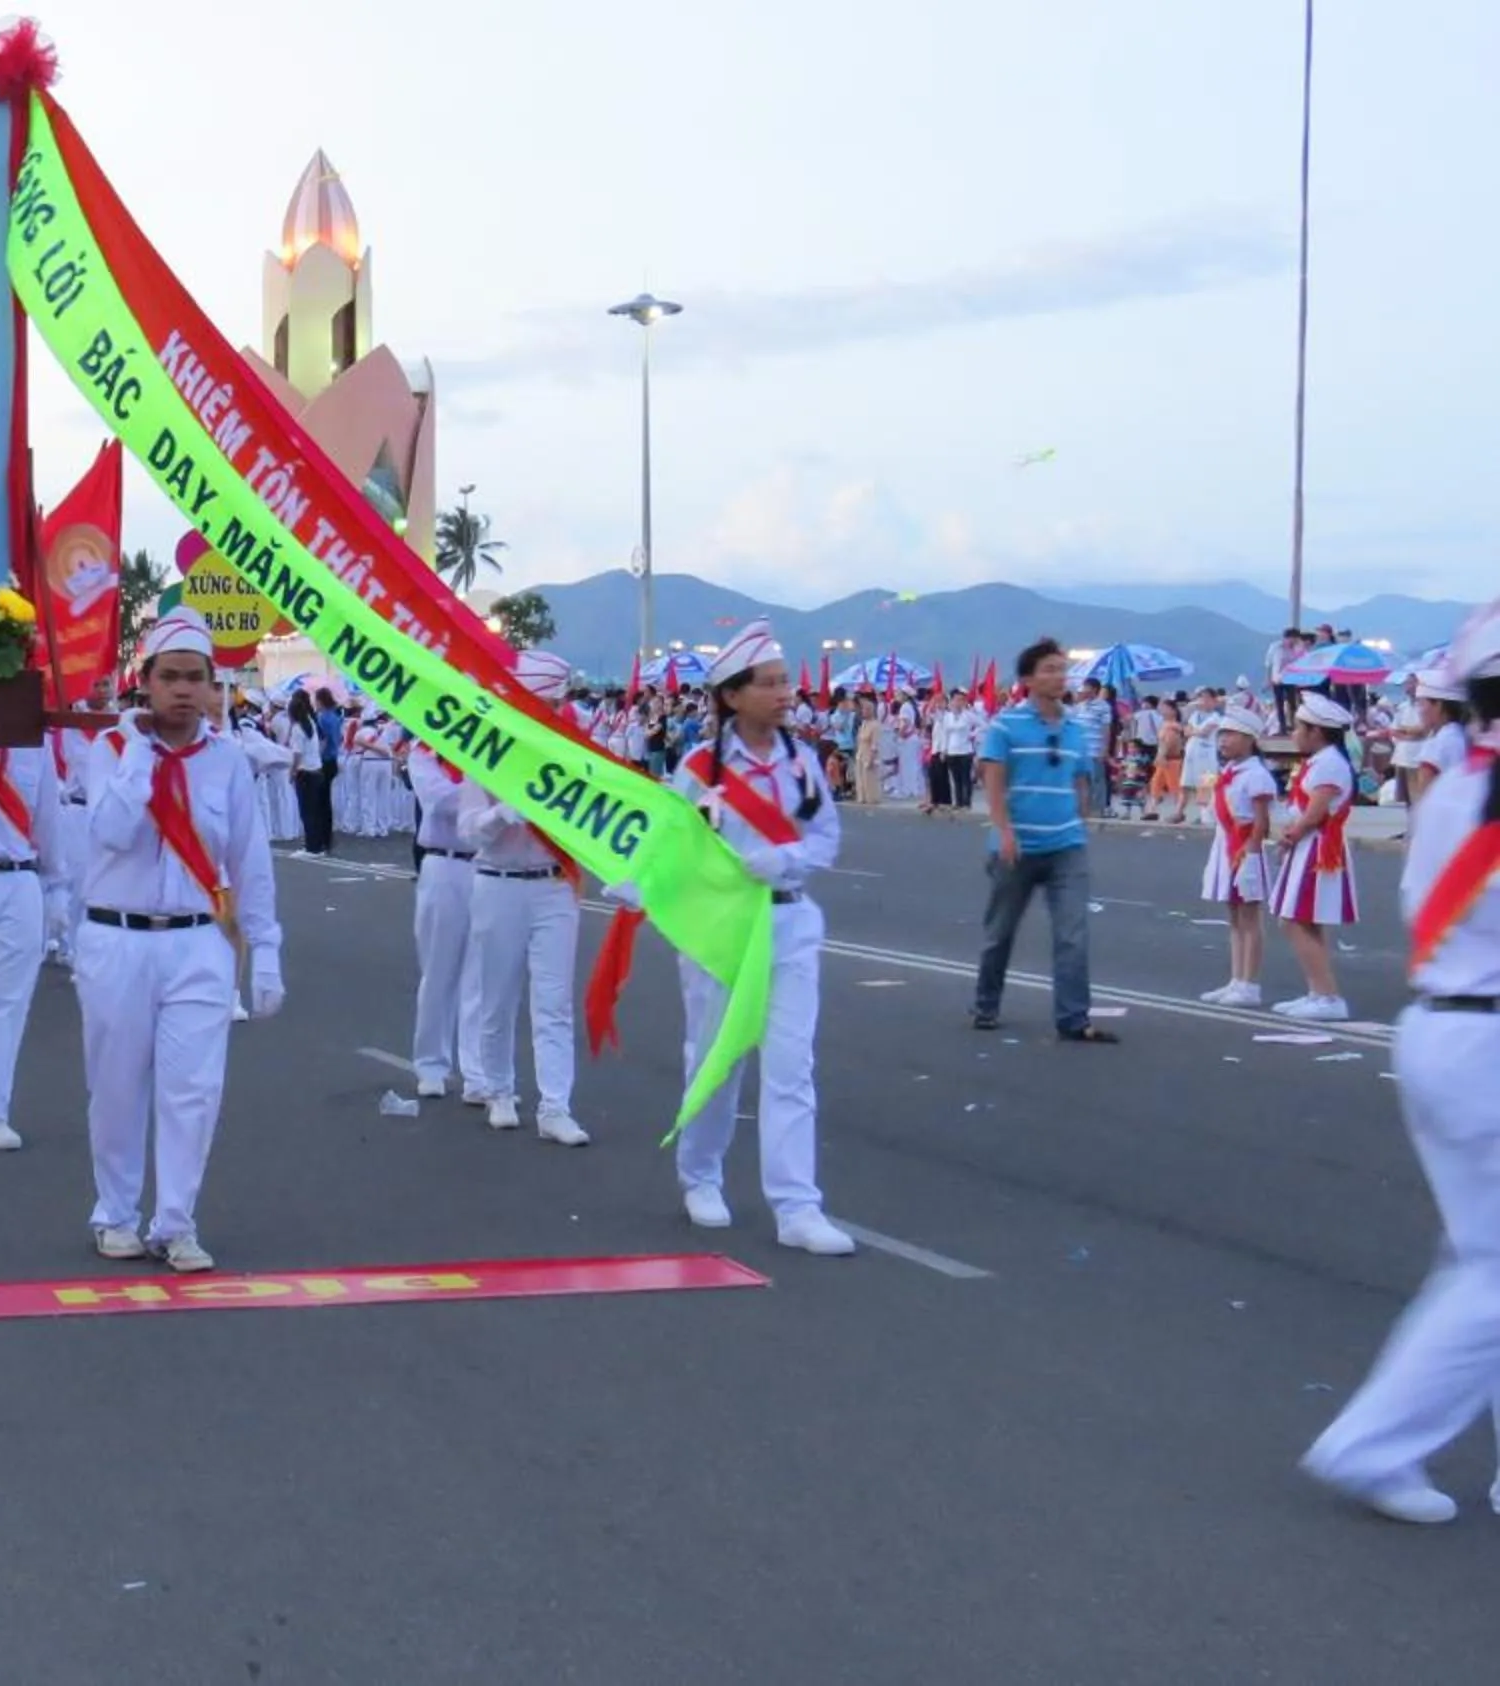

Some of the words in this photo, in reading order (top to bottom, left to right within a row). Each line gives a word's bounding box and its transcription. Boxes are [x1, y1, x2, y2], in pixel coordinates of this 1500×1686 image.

[158, 329, 255, 462] KHIÊM
[77, 328, 142, 420] BÁC
[216, 515, 325, 631] MĂNG
[328, 623, 419, 705] NON
[525, 761, 649, 860] SÀNG
